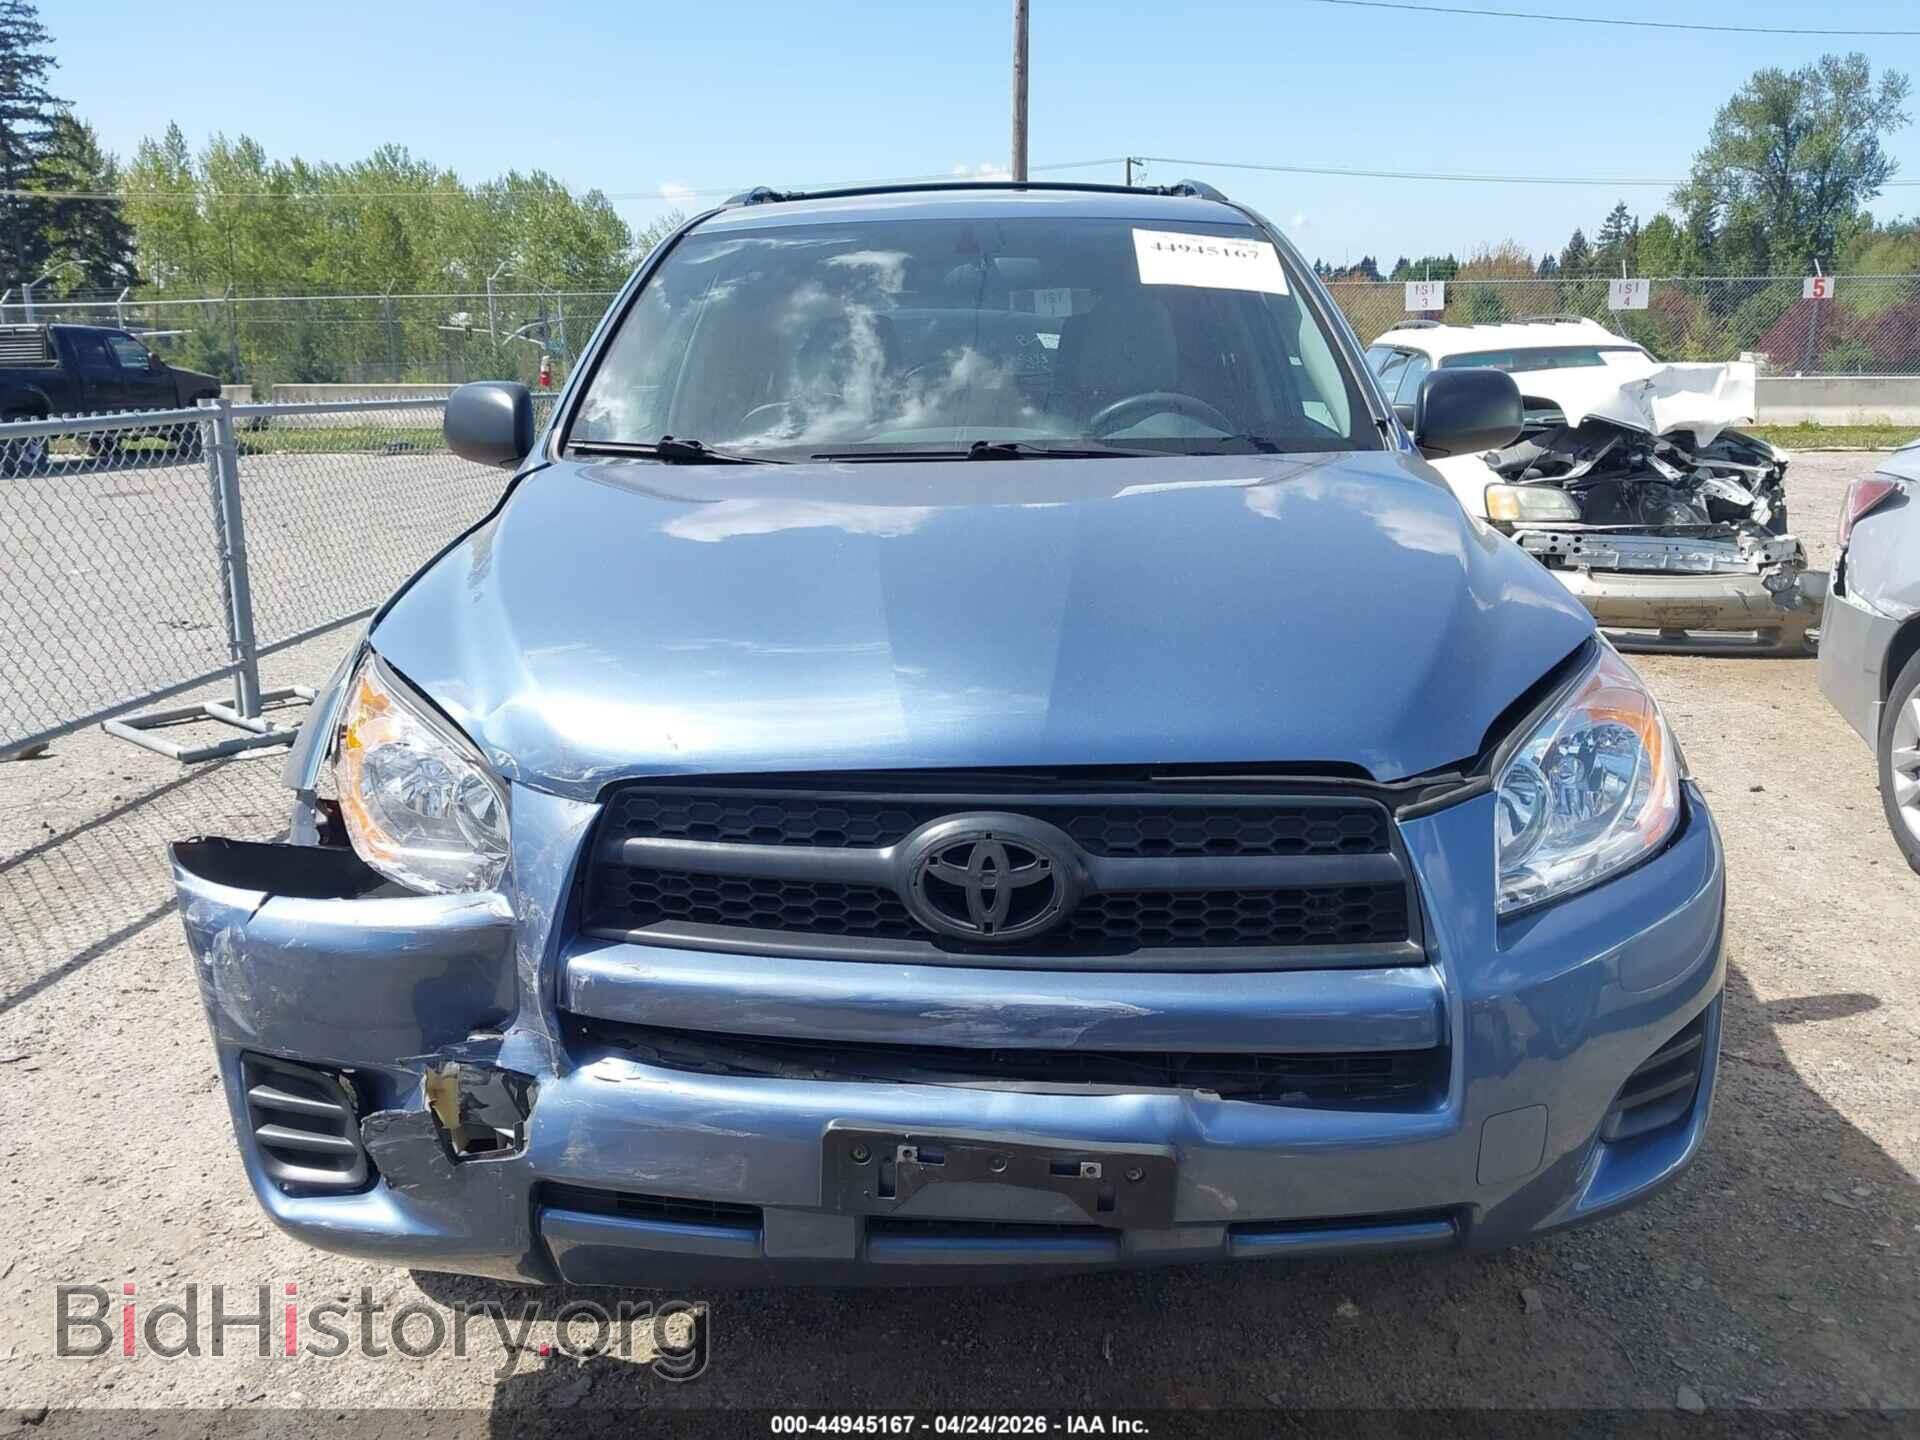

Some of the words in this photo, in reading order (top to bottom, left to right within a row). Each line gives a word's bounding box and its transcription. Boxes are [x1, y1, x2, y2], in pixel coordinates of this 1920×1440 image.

[1150, 241, 1259, 260] 44945167
[1813, 279, 1825, 297] 5
[1422, 298, 1428, 308] 3
[1623, 296, 1631, 306] 4
